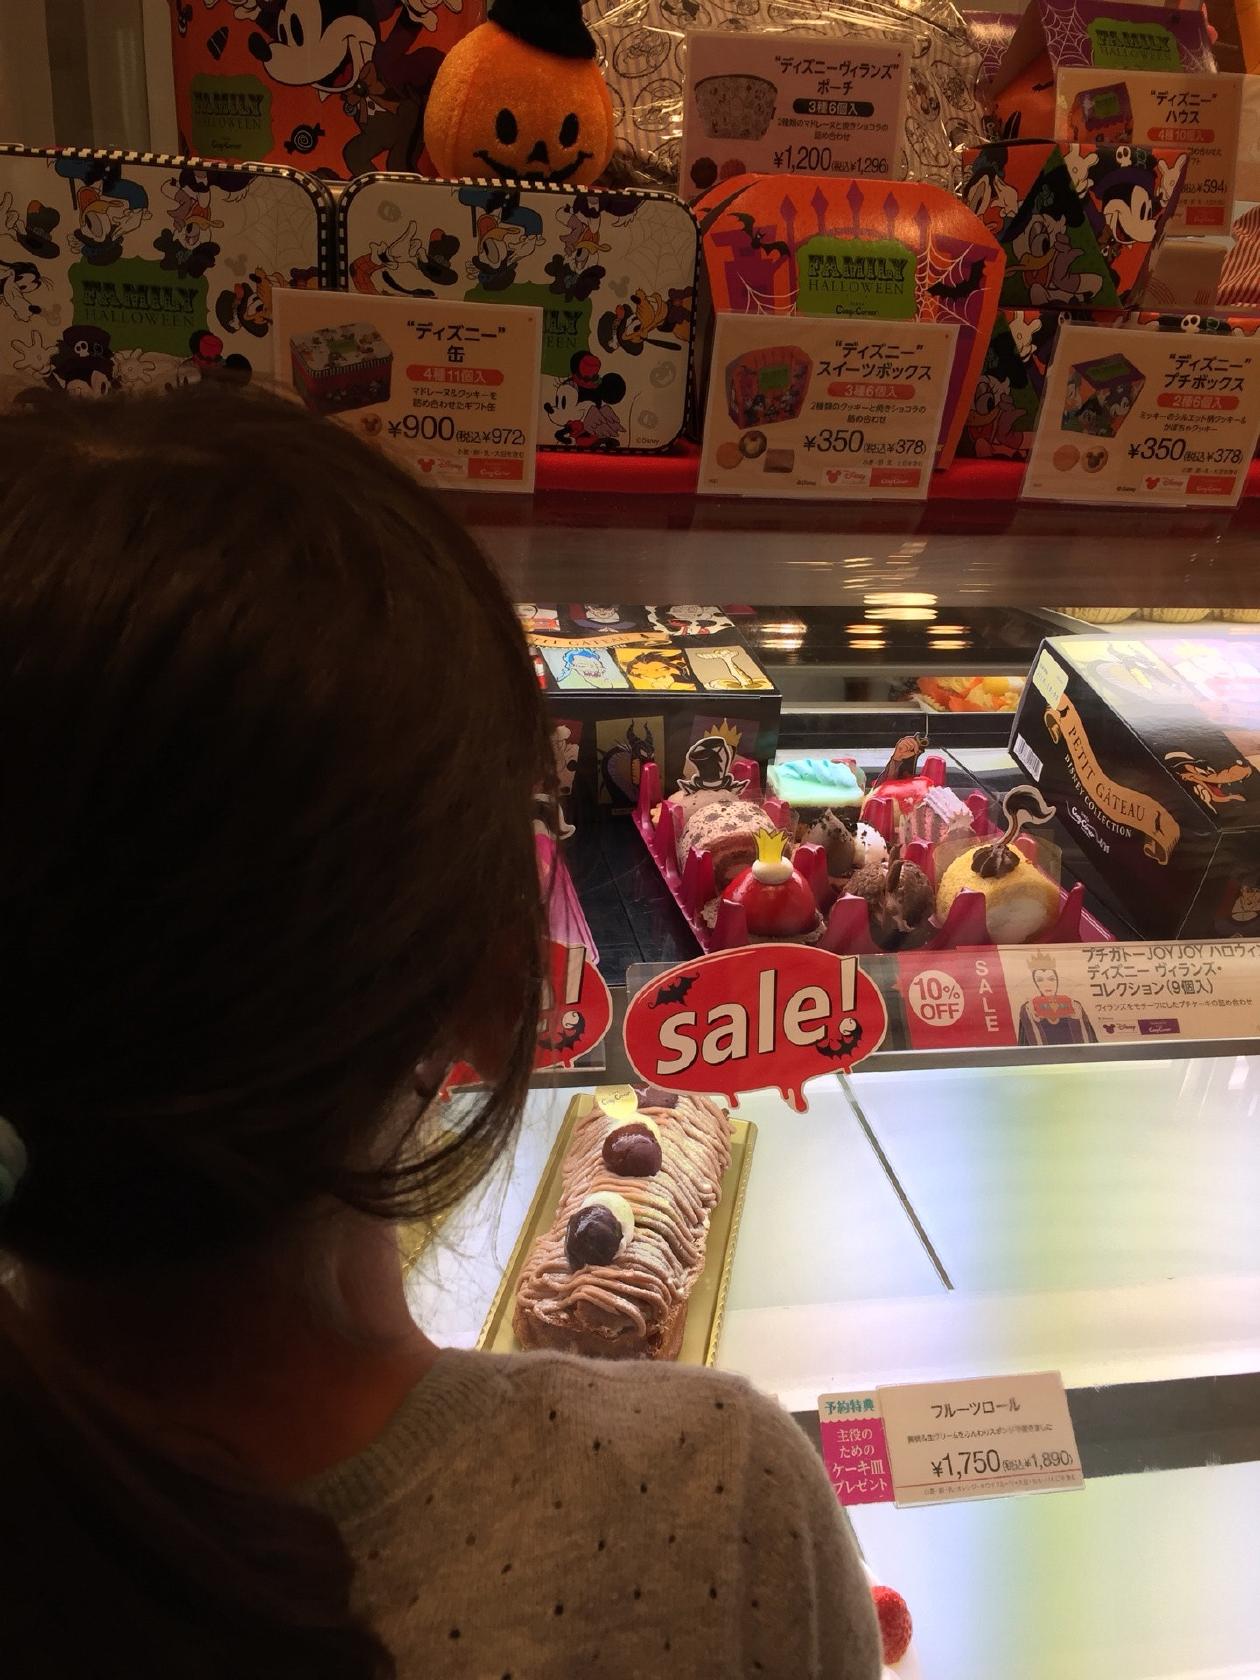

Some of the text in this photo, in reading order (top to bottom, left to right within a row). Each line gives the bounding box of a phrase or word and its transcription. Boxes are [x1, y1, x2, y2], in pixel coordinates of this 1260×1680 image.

[817, 80, 853, 96] ポーチ
[808, 101, 858, 116] 3種6個入
[1165, 109, 1200, 125] ハウス
[808, 254, 908, 282] FAMILY
[81, 279, 199, 314] FAMILY
[808, 279, 904, 295] HALLOWEEN
[84, 307, 195, 328] HALLOWEEN
[447, 345, 465, 363] 缶
[423, 366, 487, 384] 4種11個入
[817, 360, 932, 381] スイーツボックス
[844, 385, 898, 399] 3種6個入
[1163, 373, 1245, 392] プチボックス
[1172, 396, 1223, 409] 2種6個入
[1068, 725, 1146, 823] PETIT GÂTEAU
[1064, 754, 1133, 838] DISNEY COLLECTION
[1209, 944, 1260, 959] ハロウィ
[914, 978, 960, 1002] 10%
[975, 959, 1000, 1033] SALE
[656, 956, 859, 1076] sale!
[920, 1002, 960, 1020] OFF
[824, 1397, 875, 1416] 予約特典
[931, 1397, 1020, 1420] フルーツロール
[836, 1427, 873, 1444] 主役の
[839, 1444, 875, 1459] ための
[832, 1459, 886, 1479] ケーキ皿
[832, 1477, 888, 1496] プレゼント
